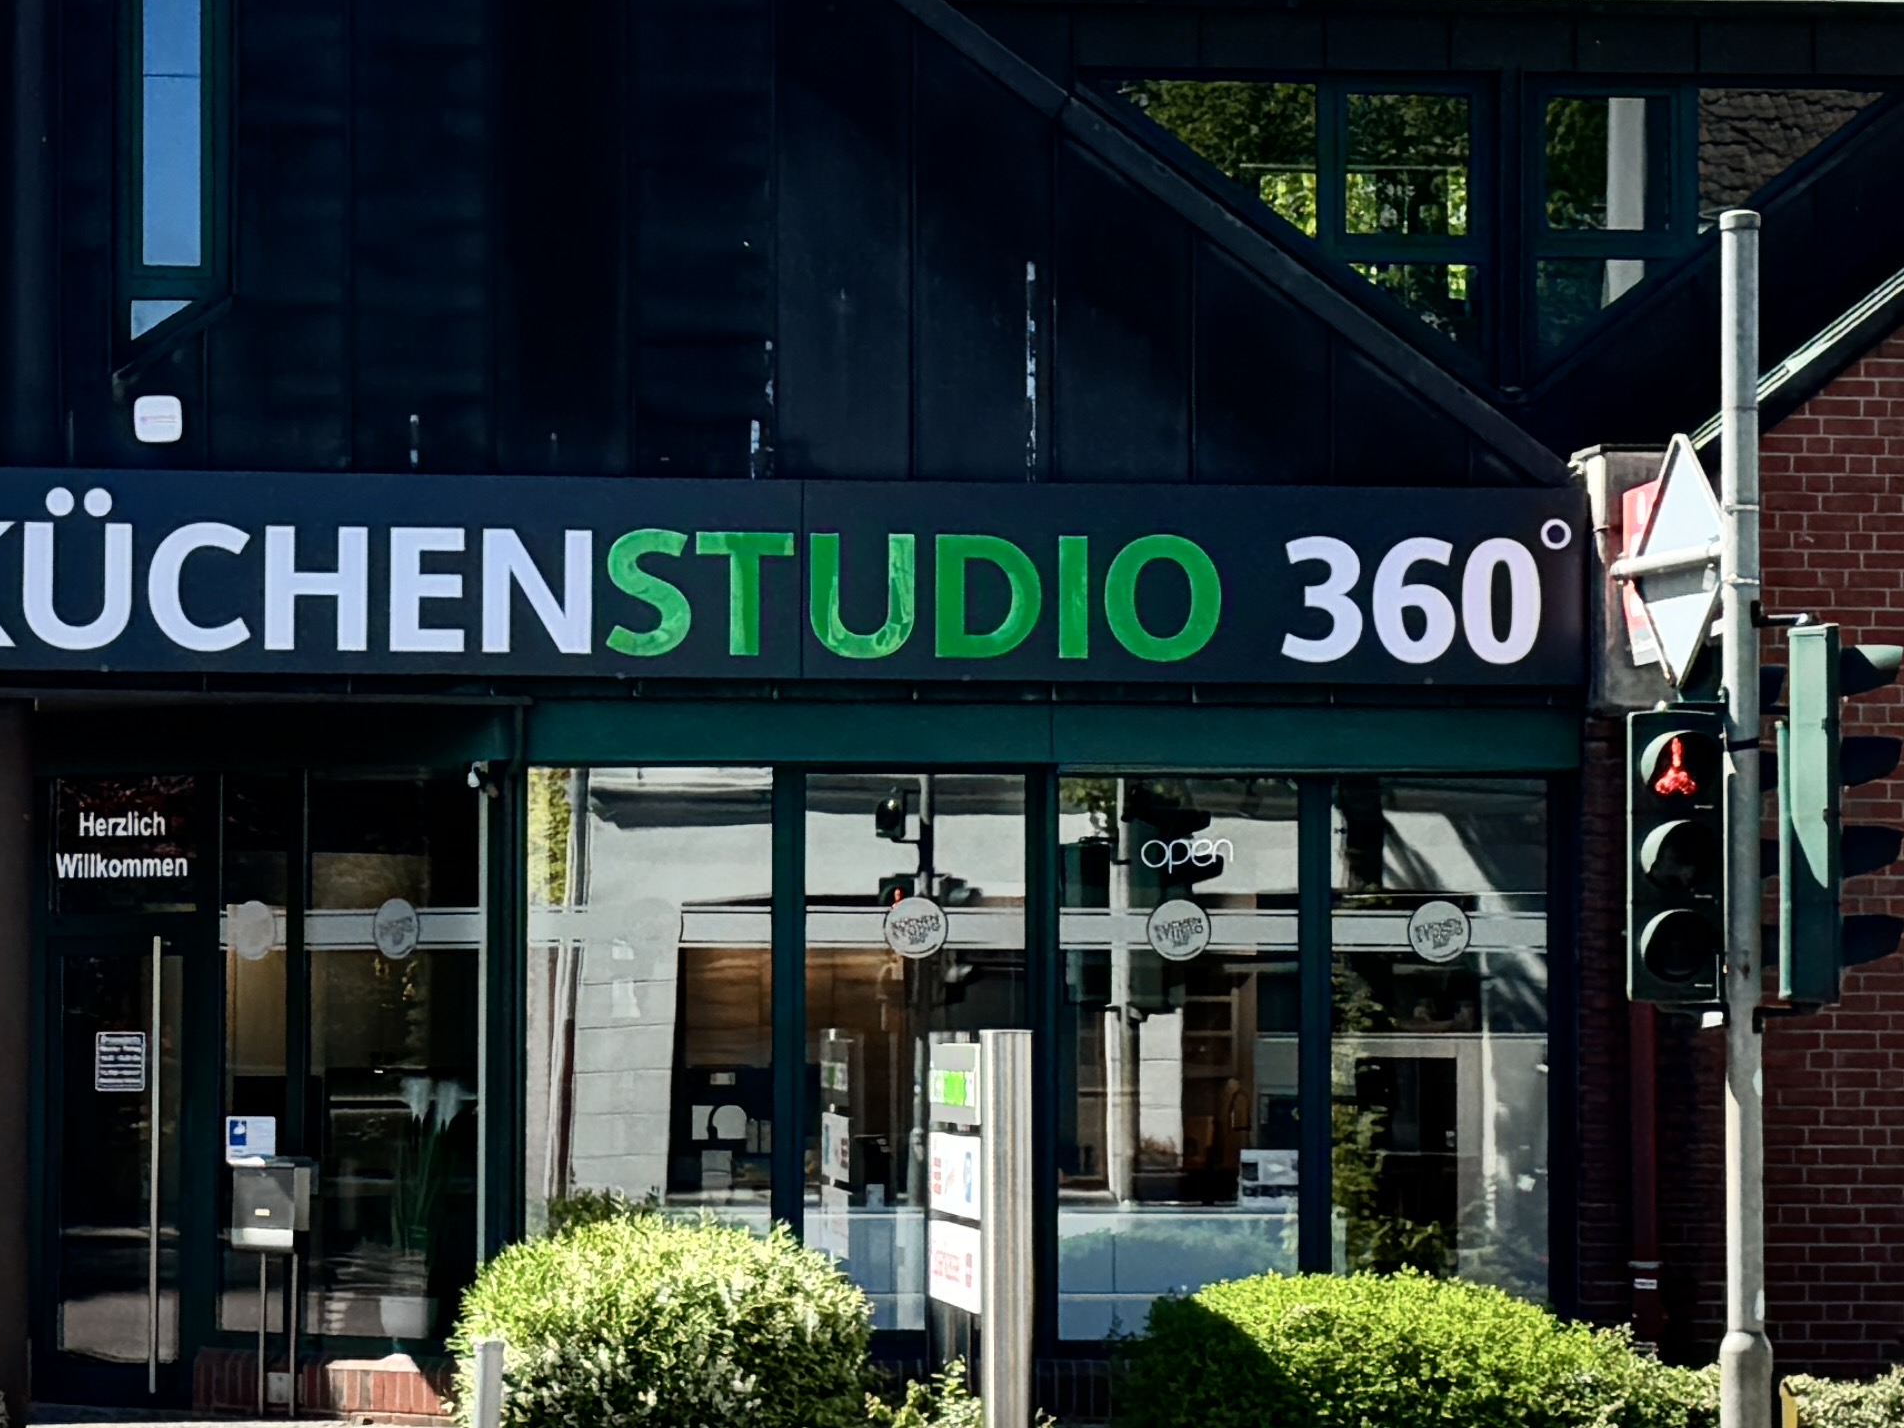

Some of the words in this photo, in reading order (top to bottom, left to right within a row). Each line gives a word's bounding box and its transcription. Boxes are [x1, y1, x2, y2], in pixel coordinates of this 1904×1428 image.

[1280, 517, 1572, 665] 360°
[78, 810, 166, 837] Herzlich
[55, 852, 188, 879] Willkommen
[1141, 839, 1233, 874] open
